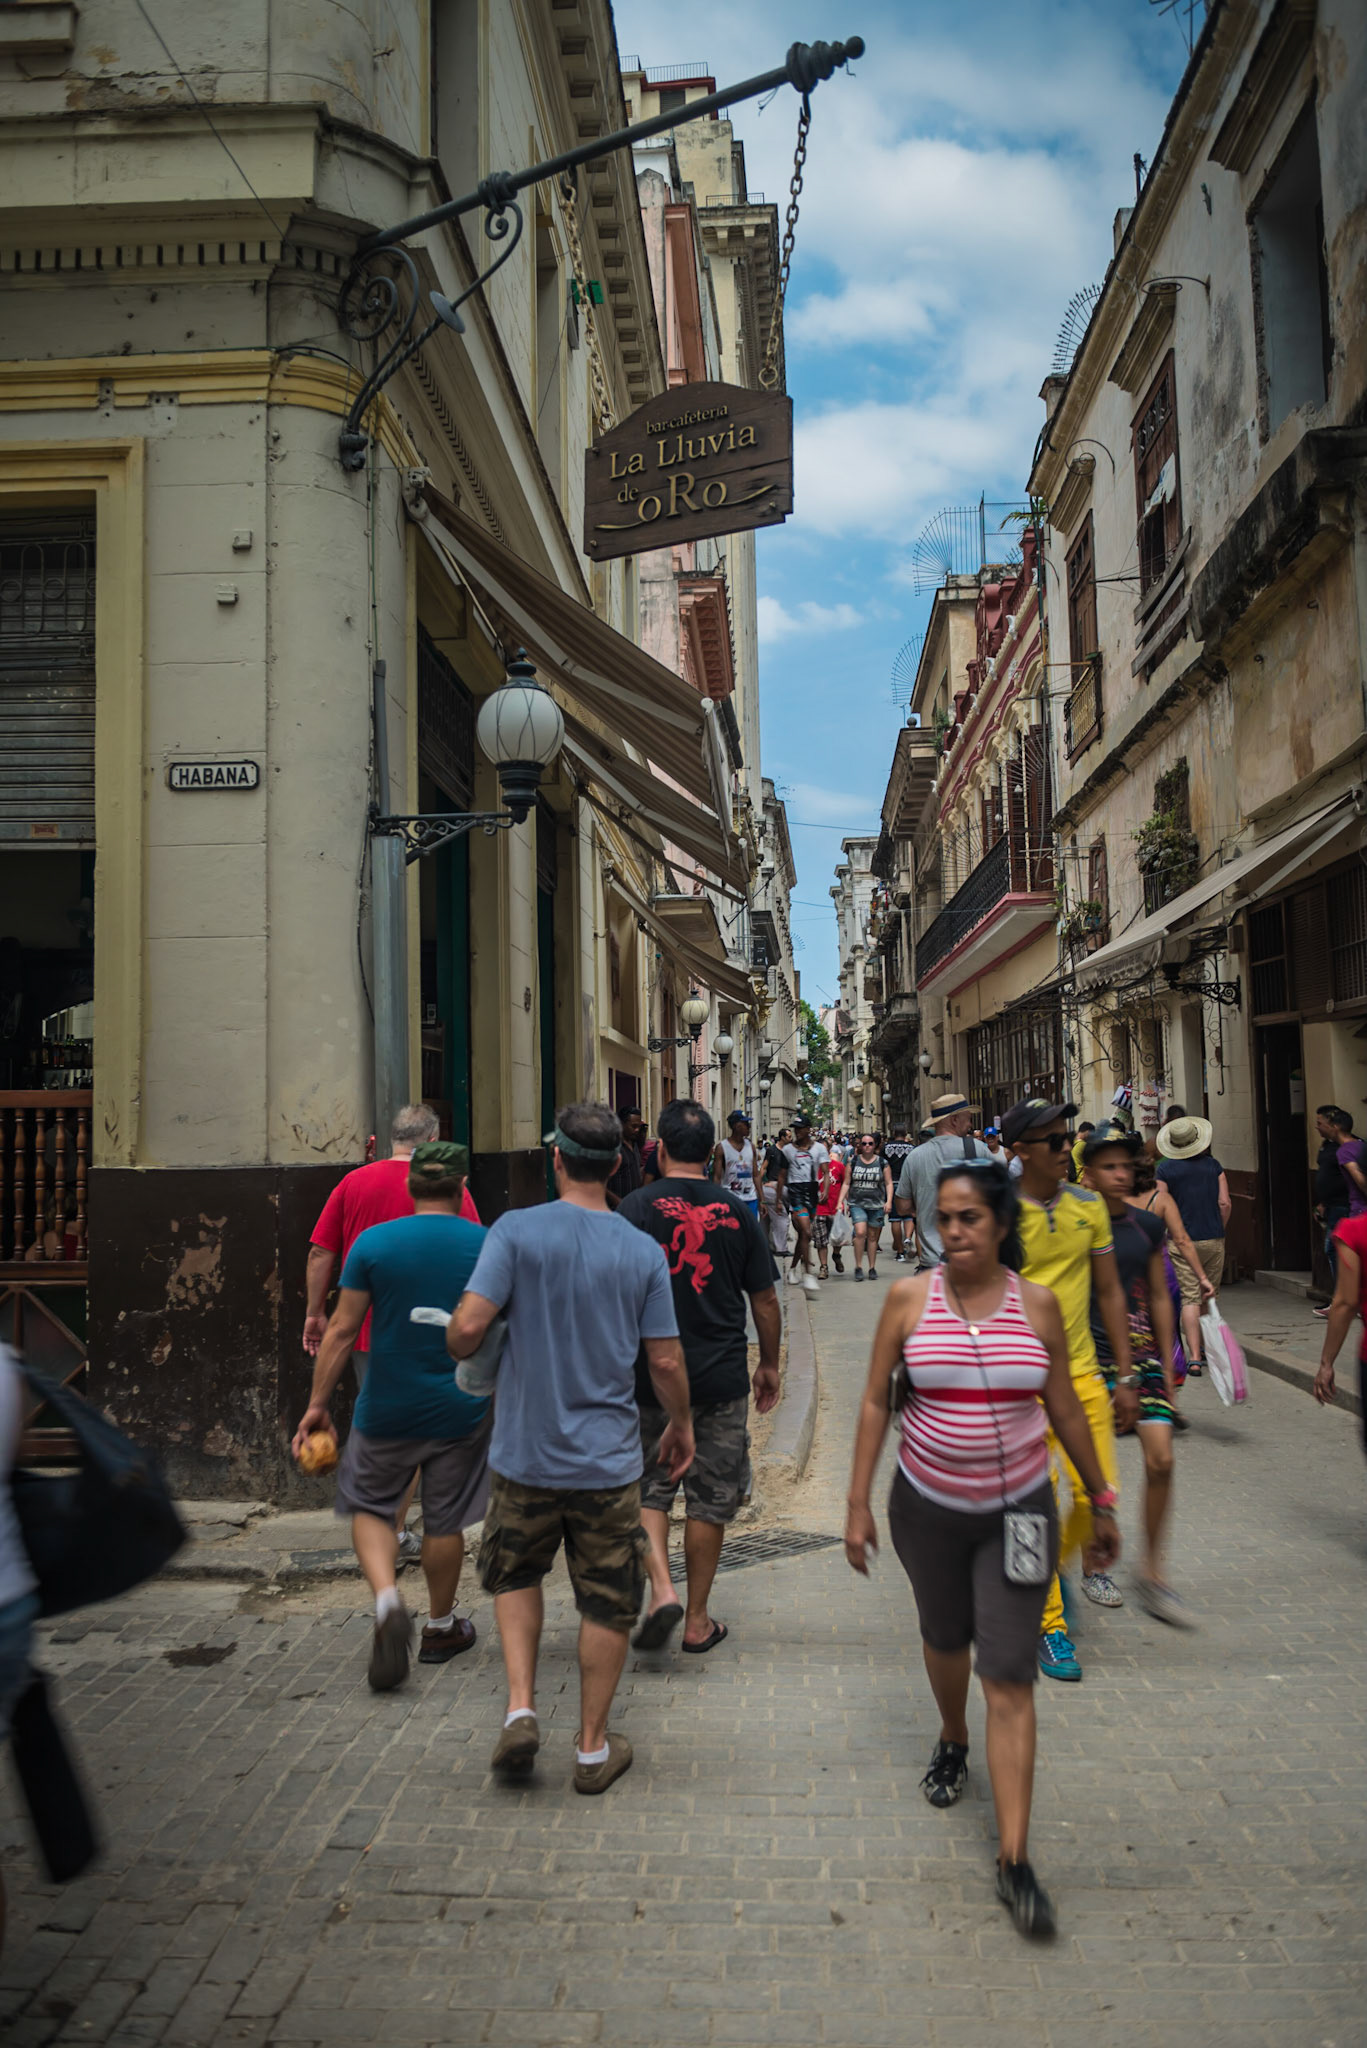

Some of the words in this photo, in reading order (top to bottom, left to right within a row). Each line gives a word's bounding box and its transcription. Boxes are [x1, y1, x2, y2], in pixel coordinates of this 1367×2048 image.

[609, 451, 645, 479] La
[656, 423, 757, 468] Lluvia
[617, 483, 639, 503] de
[179, 767, 249, 785] HABANA
